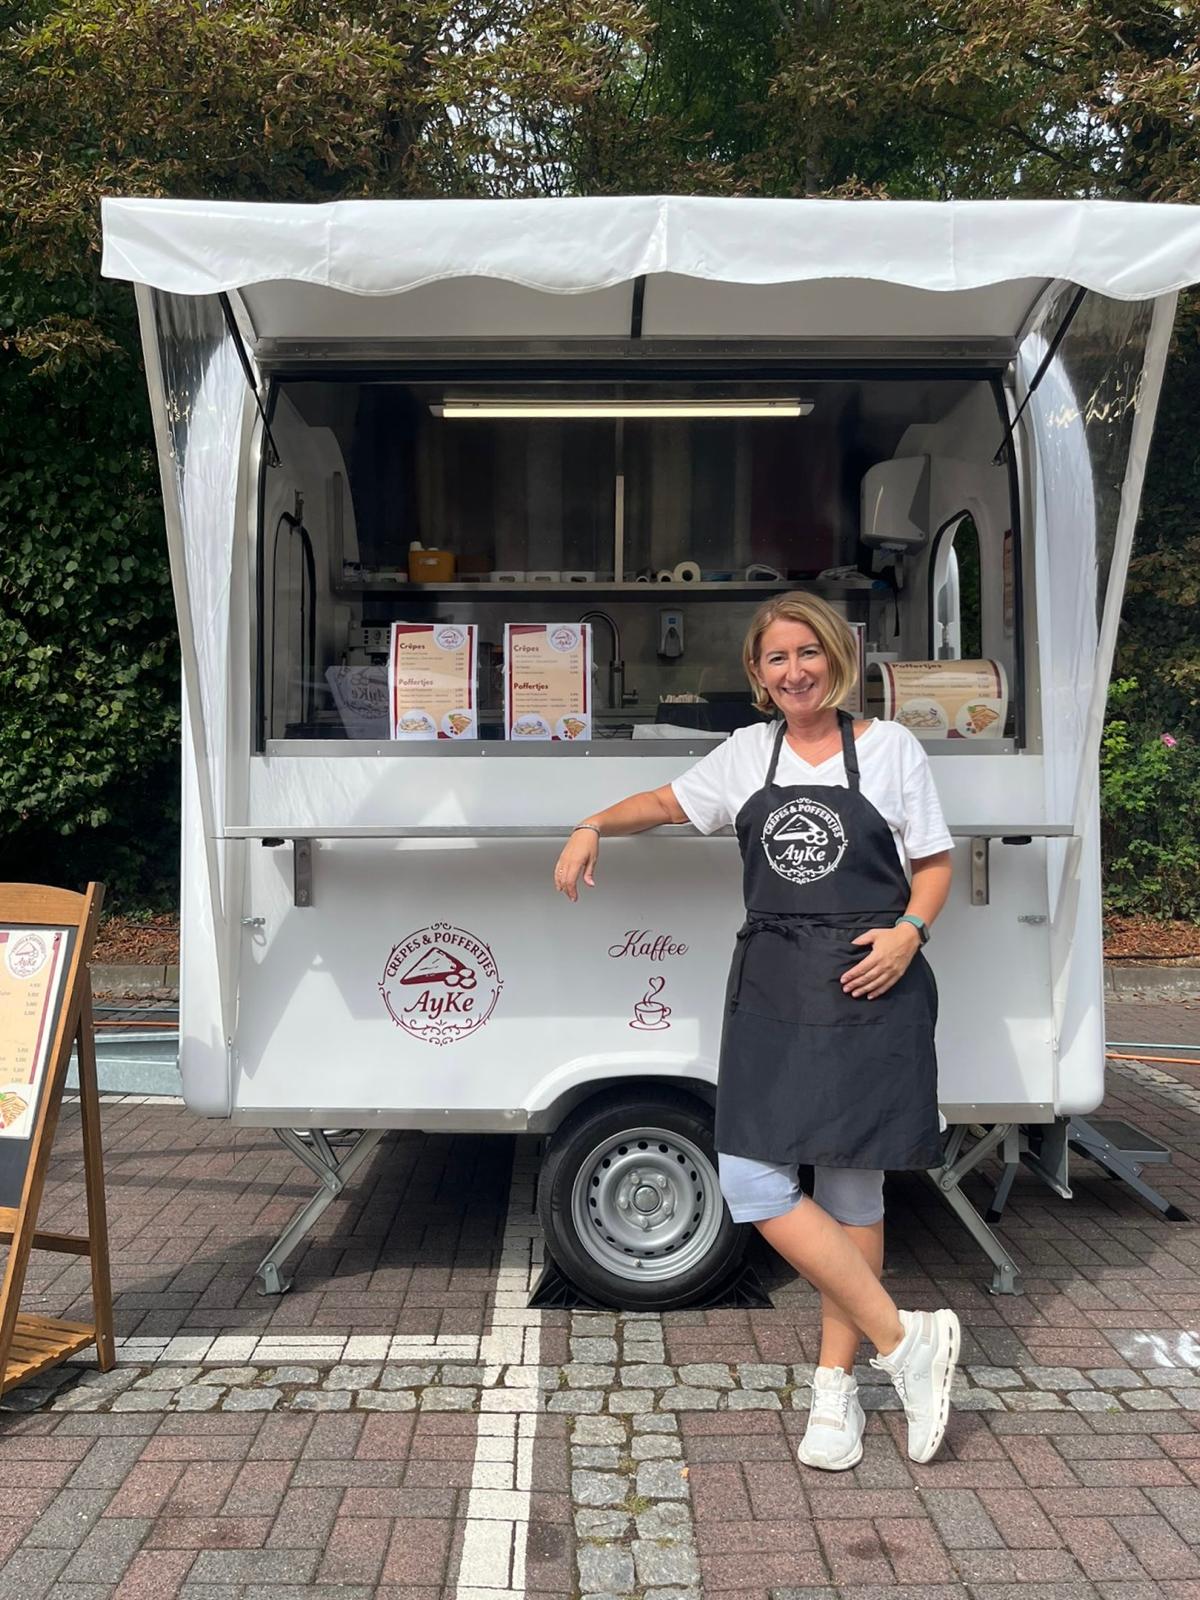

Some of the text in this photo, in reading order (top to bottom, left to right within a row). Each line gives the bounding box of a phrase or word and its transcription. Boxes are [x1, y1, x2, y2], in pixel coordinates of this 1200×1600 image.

[400, 643, 425, 651] Crêpes
[513, 645, 539, 653] Crêpes
[399, 678, 433, 687] Poffertjes
[513, 682, 548, 691] Poffertjes
[764, 804, 842, 838] CREPES & POFFERTJES
[775, 844, 826, 866] AyKe
[386, 932, 496, 978] CREPES & POFFERTJES
[607, 929, 690, 961] Kaffee
[404, 990, 474, 1020] AyKe
